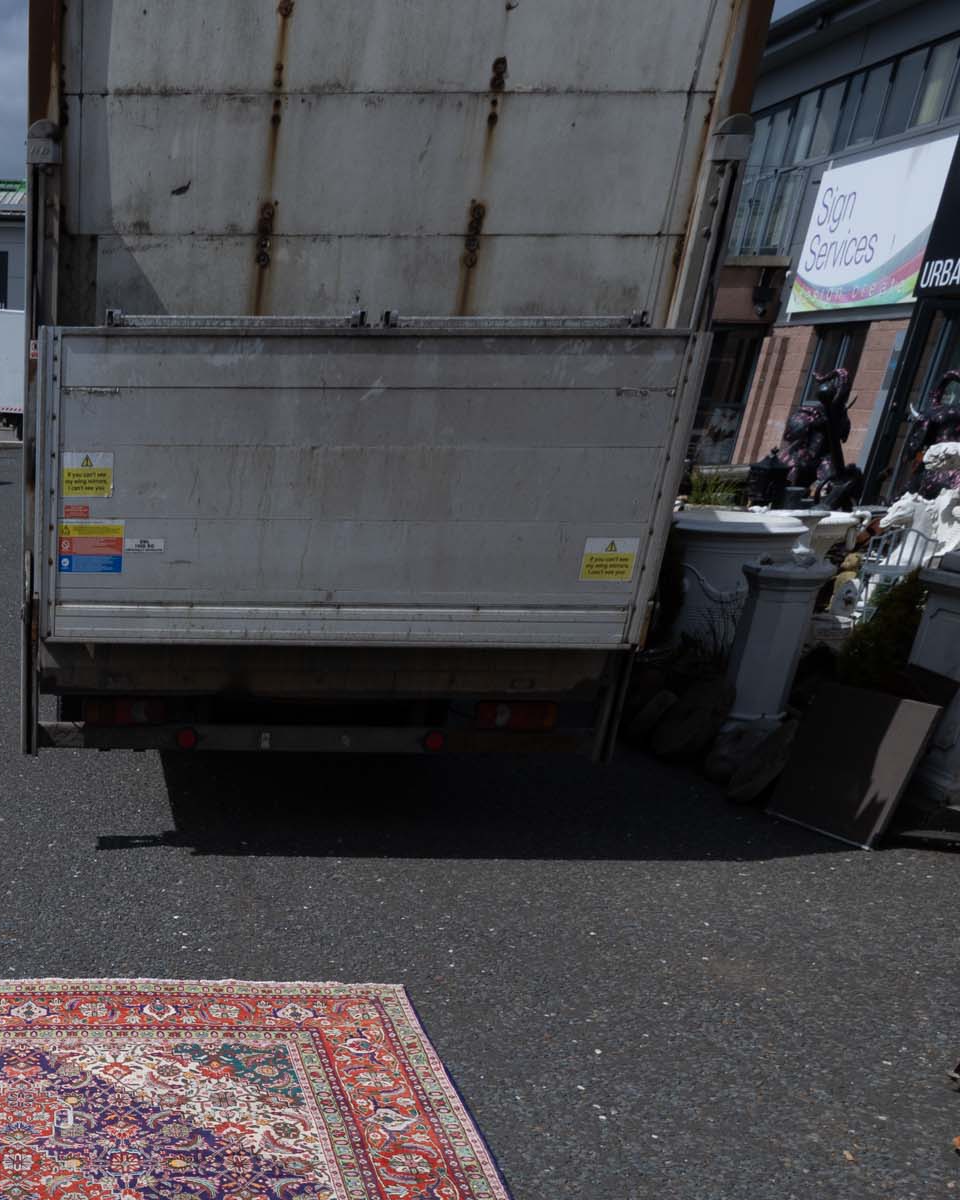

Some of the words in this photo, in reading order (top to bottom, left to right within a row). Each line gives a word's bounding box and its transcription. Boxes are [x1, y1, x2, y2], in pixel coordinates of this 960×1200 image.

[817, 185, 856, 233] Sign
[805, 226, 878, 272] Services
[920, 257, 960, 288] URBA
